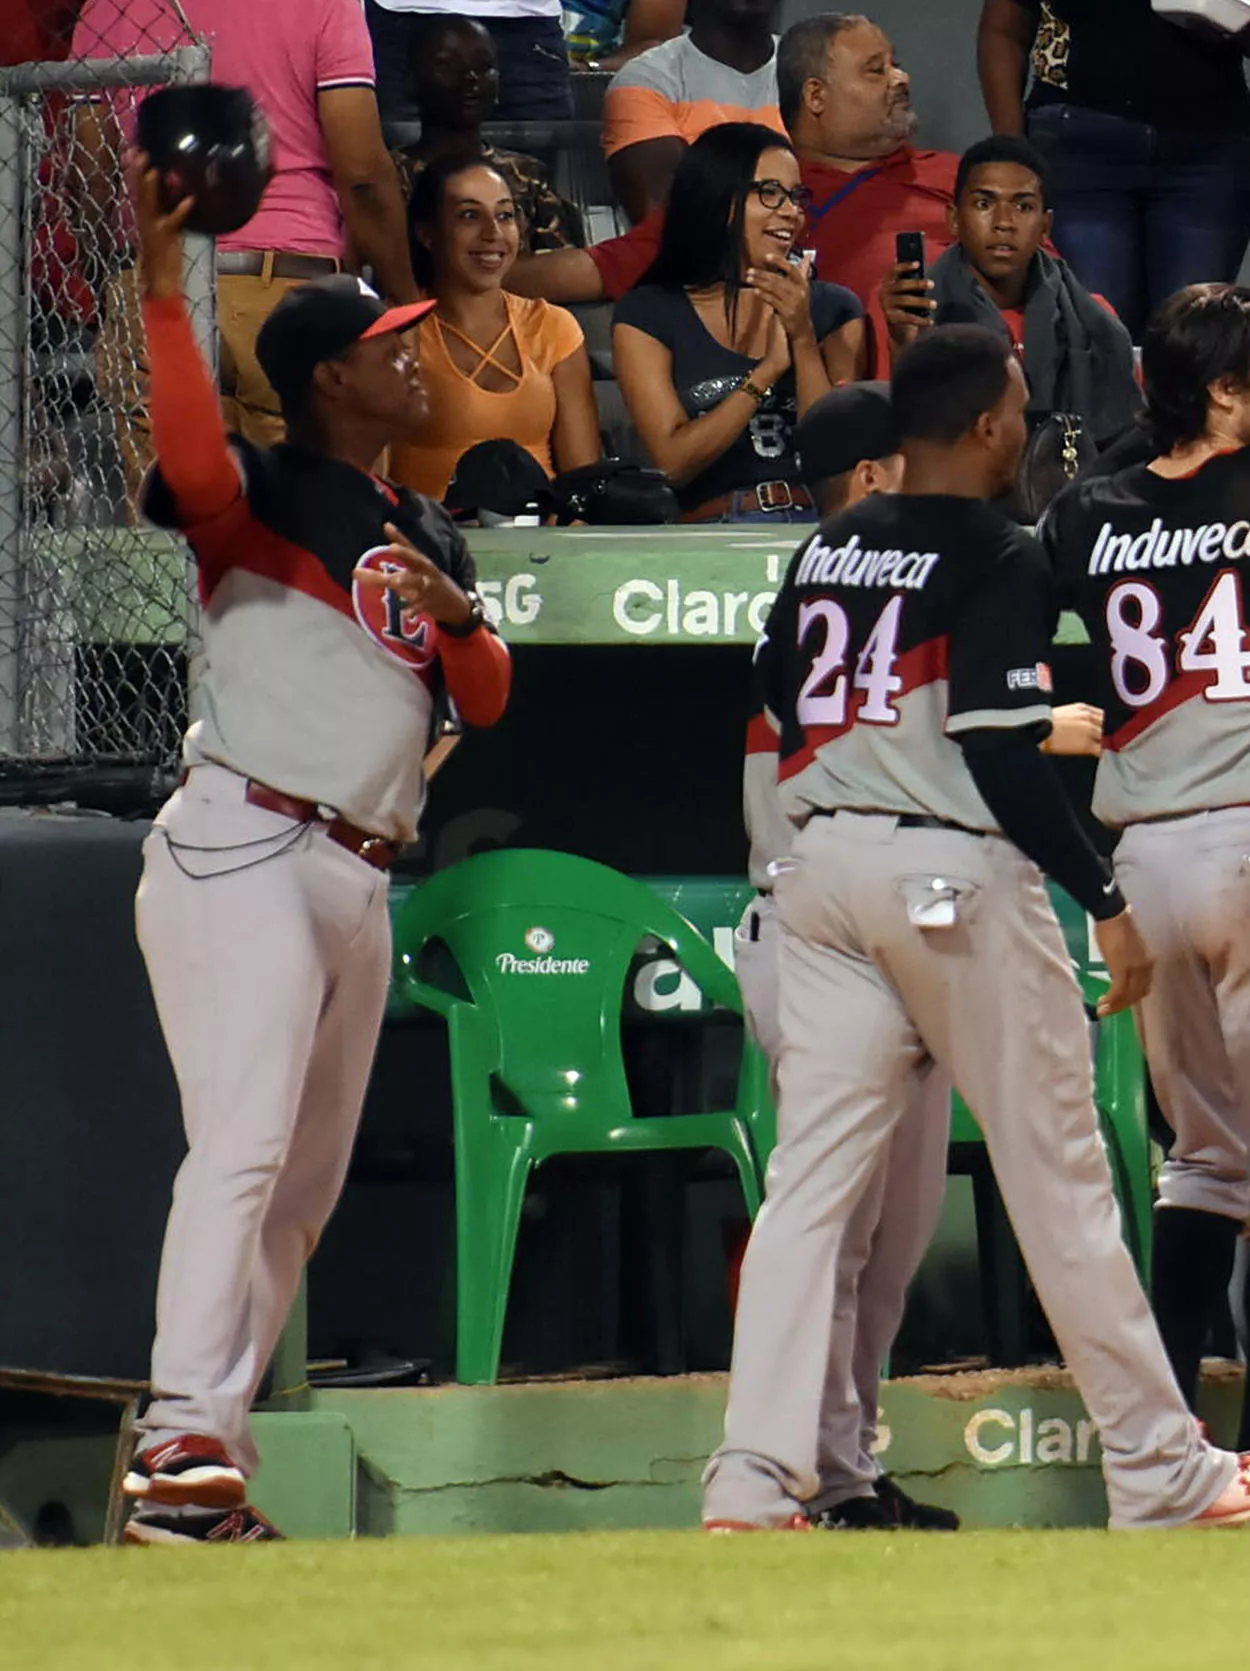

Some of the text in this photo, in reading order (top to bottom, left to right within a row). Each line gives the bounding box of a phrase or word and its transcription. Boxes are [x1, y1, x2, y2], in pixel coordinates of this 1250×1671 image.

[795, 534, 940, 590] Induveca
[796, 594, 904, 725] 24
[495, 952, 591, 975] Presidente
